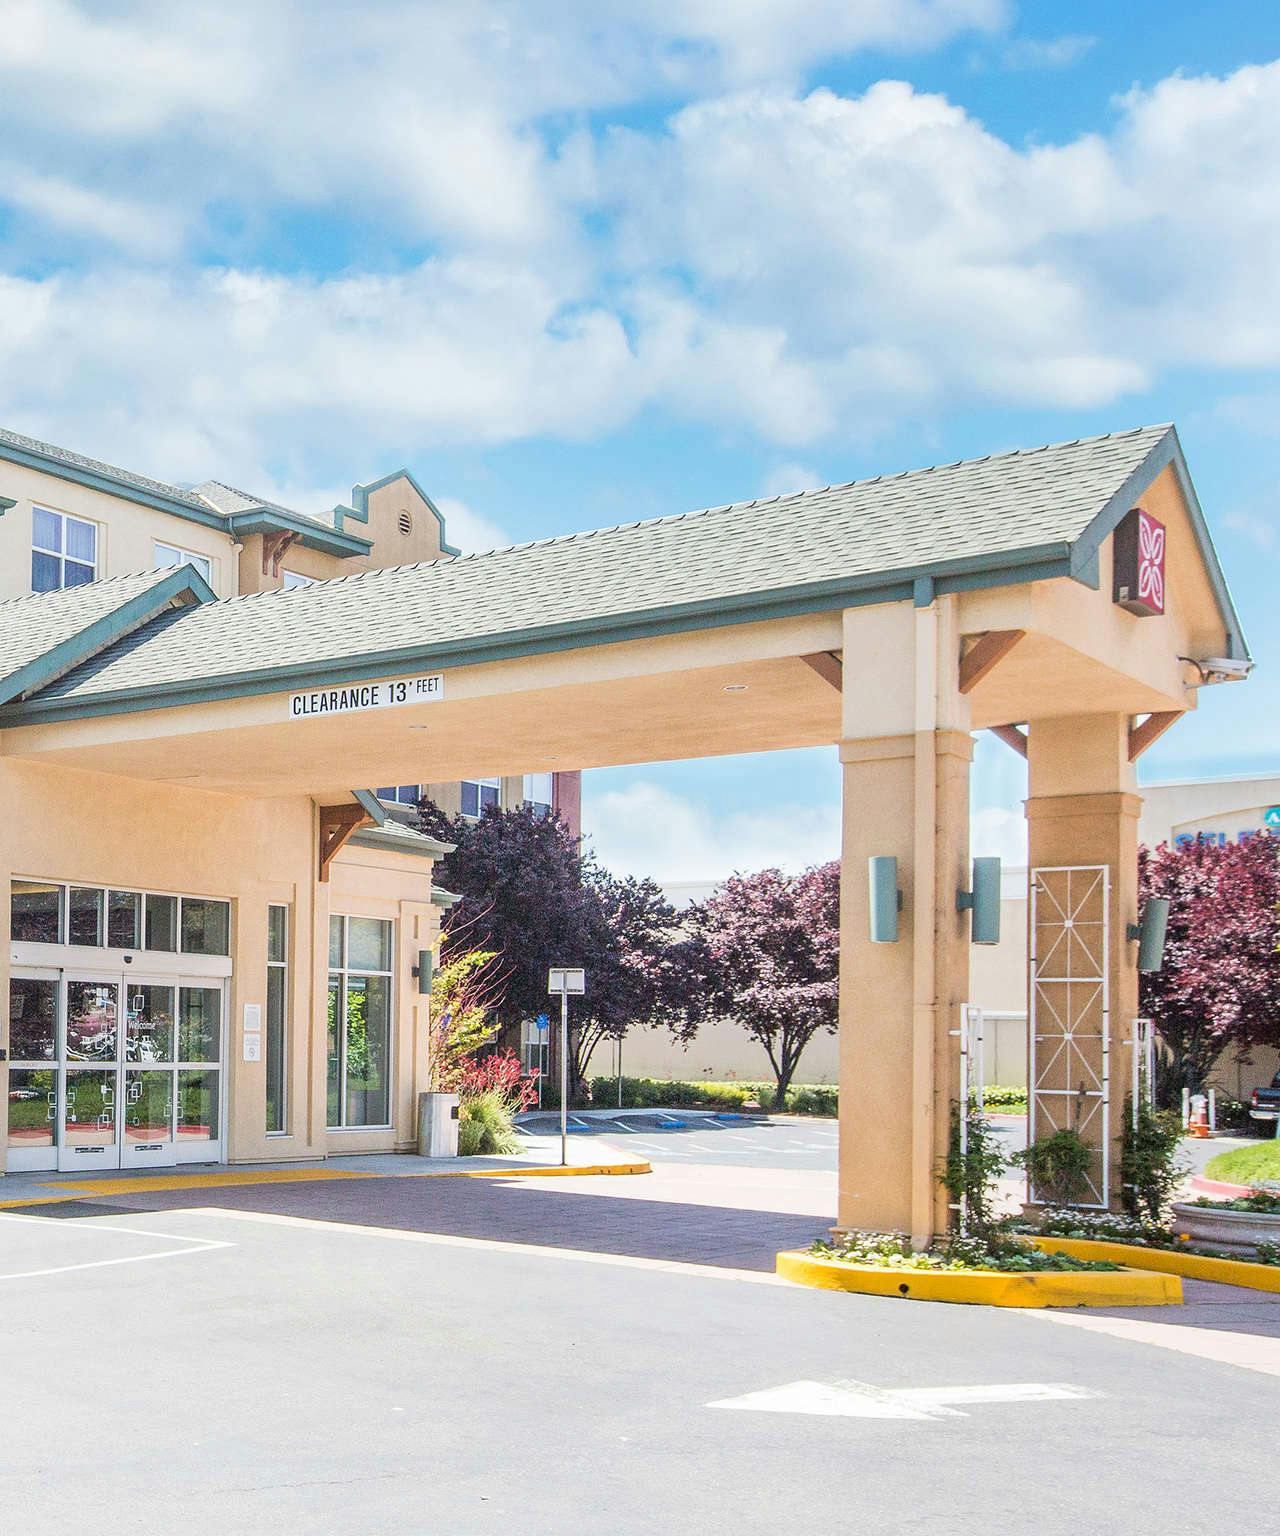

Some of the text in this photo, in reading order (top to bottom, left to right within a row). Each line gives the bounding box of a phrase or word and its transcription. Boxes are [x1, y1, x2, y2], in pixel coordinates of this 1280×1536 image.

[293, 686, 380, 715] CLEARANCE
[416, 677, 440, 693] FEET
[128, 1021, 156, 1030] Welcome
